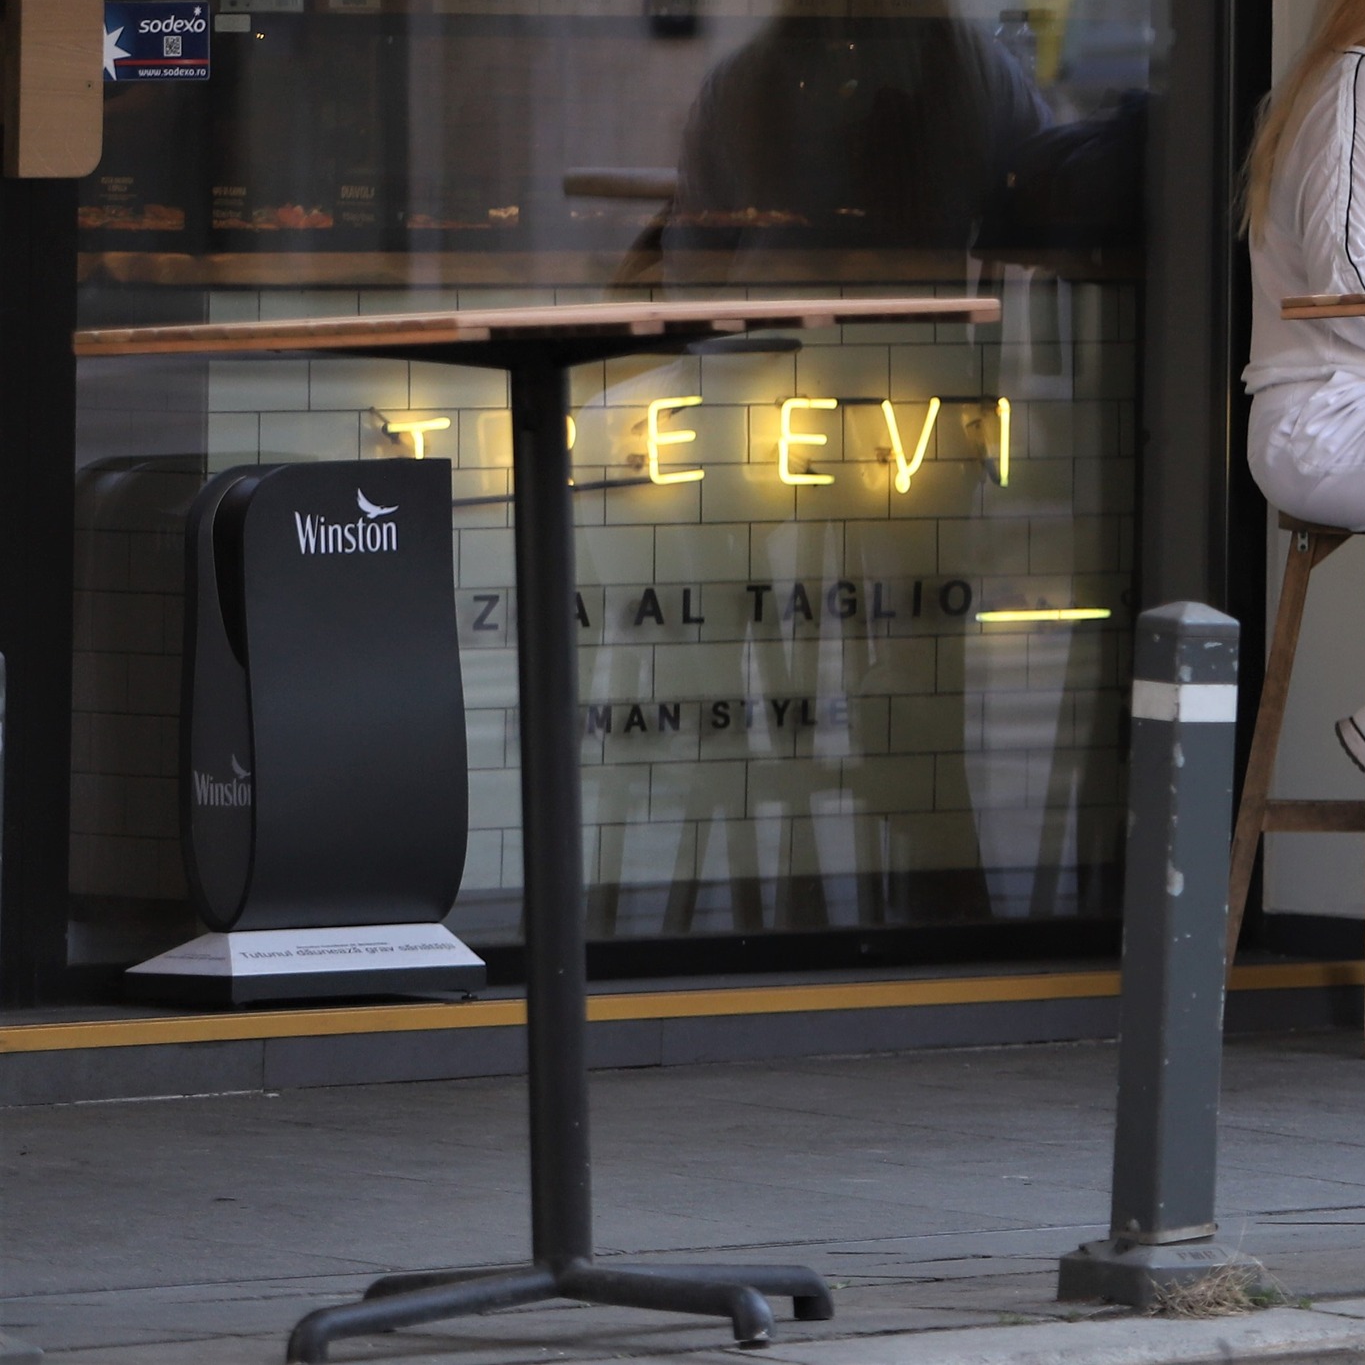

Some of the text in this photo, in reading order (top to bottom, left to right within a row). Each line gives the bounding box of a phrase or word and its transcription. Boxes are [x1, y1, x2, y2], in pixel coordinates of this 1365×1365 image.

[138, 14, 206, 33] sodexo
[138, 67, 207, 77] www.sodexo.ro
[294, 510, 398, 555] Winston
[634, 587, 706, 627] AL
[746, 579, 974, 624] TAGLIO
[587, 697, 850, 735] MAN STYLE
[239, 950, 294, 960] Tutunul
[364, 945, 395, 955] grav
